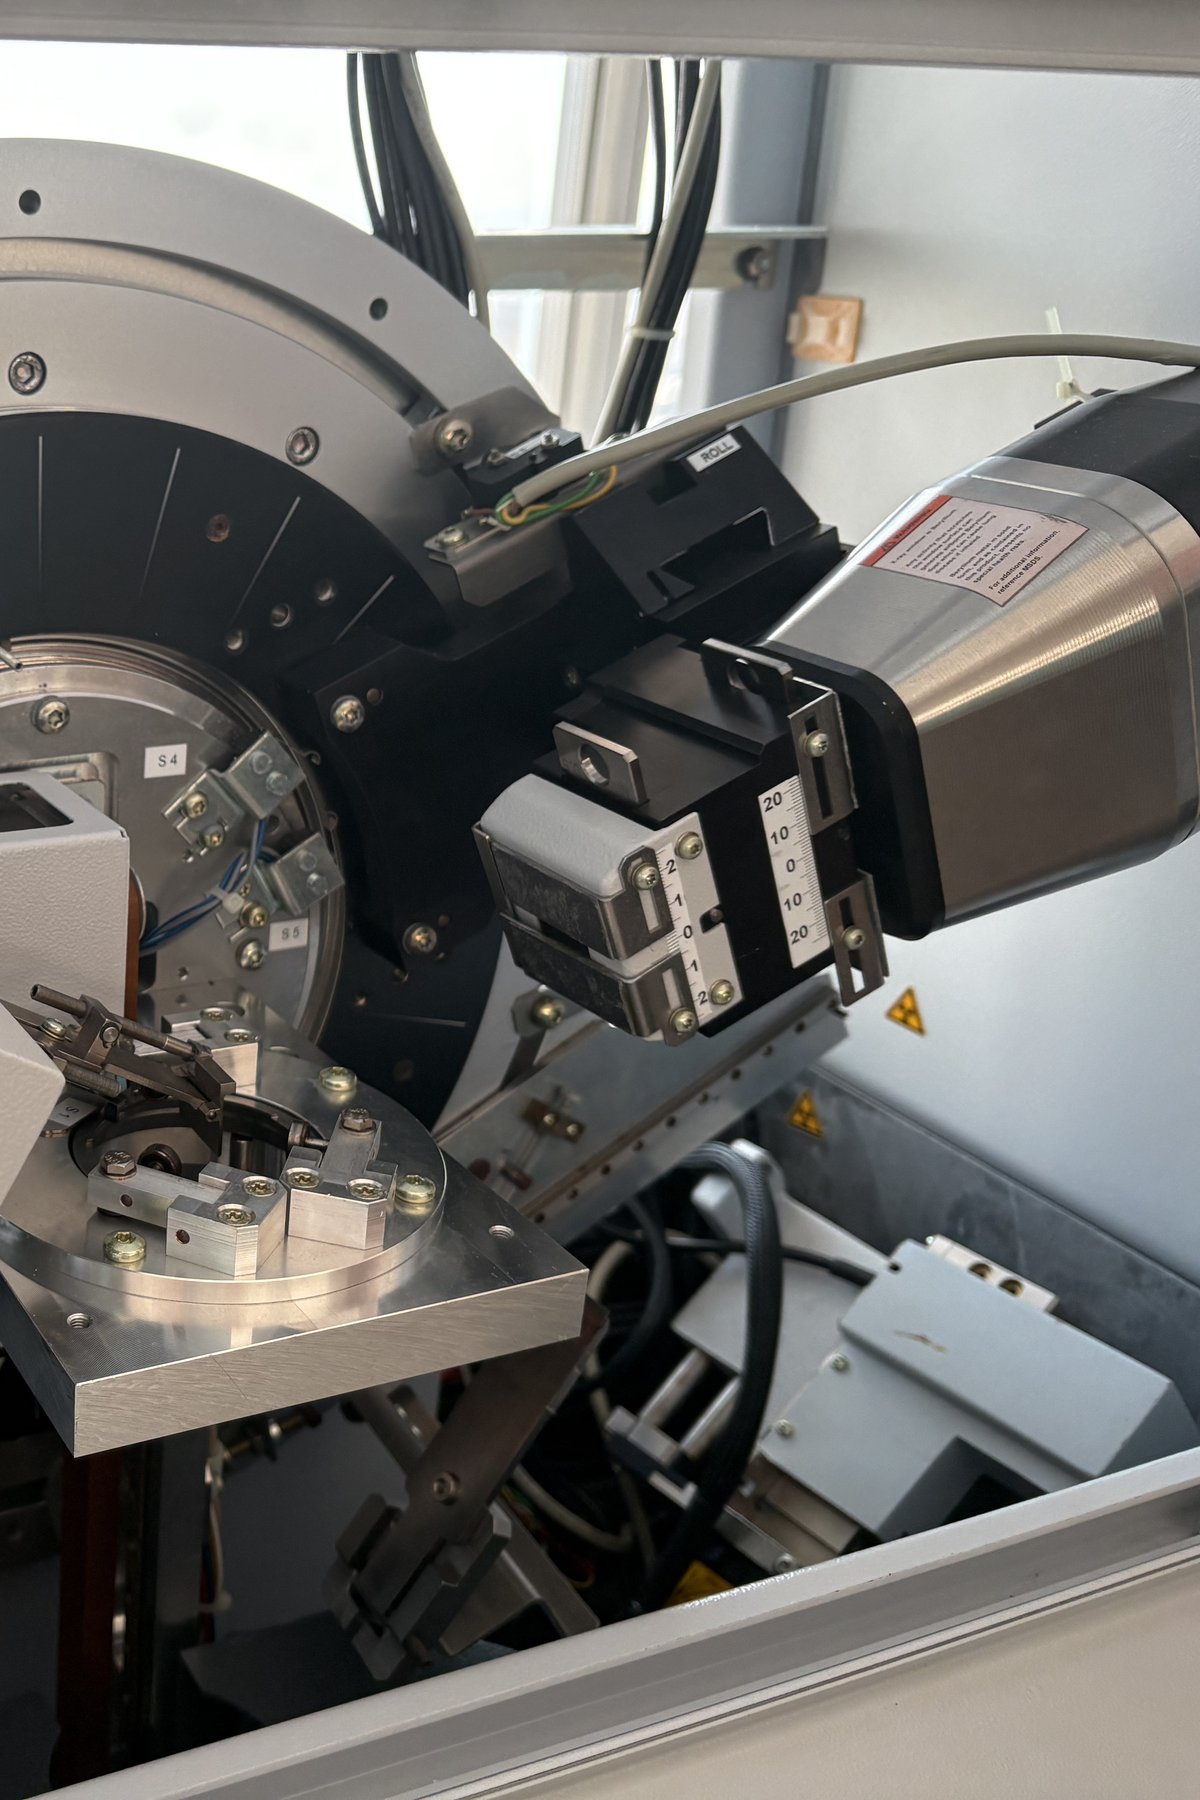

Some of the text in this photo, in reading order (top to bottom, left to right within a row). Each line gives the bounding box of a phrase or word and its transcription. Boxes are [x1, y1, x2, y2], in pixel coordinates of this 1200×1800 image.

[700, 442, 734, 463] ROLL
[916, 542, 936, 557] activity
[975, 542, 991, 555] metal
[998, 532, 1024, 552] presents
[972, 566, 994, 583] special
[991, 551, 1011, 566] health
[998, 557, 1027, 581] additional
[996, 571, 1024, 594] reference
[158, 754, 177, 767] S 4
[763, 791, 782, 812] 20
[770, 826, 789, 845] 10
[666, 859, 676, 874] 2
[786, 859, 796, 873] 0
[674, 893, 683, 907] 1
[784, 893, 802, 911] 10
[281, 926, 300, 940] S 5
[683, 925, 693, 939] 0
[790, 925, 808, 944] 20
[690, 959, 698, 972] 1
[698, 991, 708, 1005] 2
